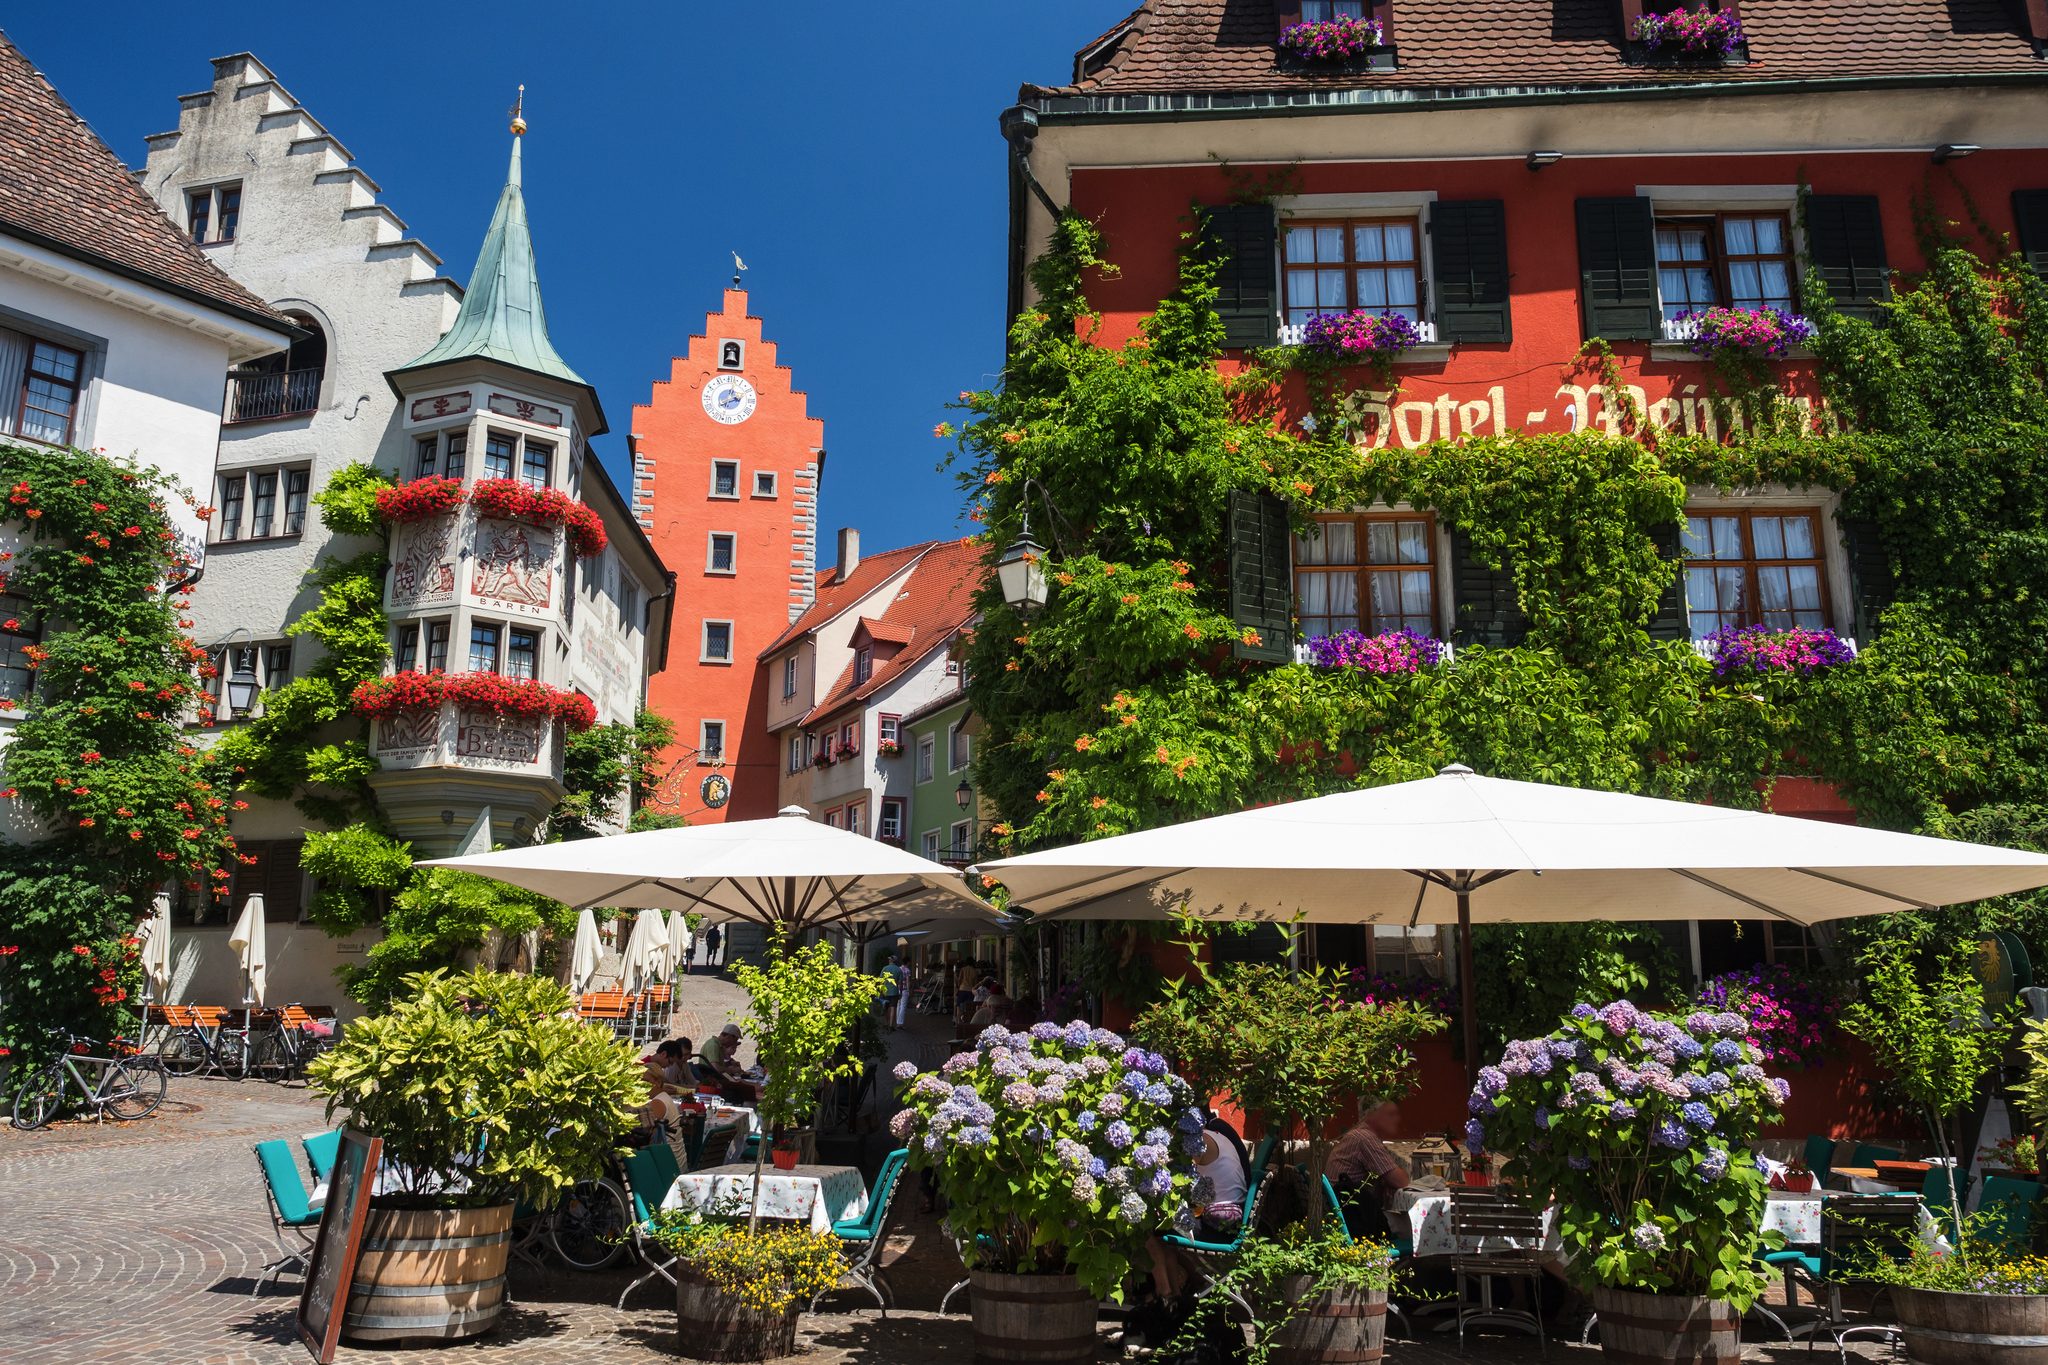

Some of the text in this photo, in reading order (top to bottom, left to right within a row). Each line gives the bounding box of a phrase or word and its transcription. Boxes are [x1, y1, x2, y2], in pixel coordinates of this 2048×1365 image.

[1343, 385, 1516, 457] Hotel
[479, 597, 540, 614] BÄREN
[465, 728, 527, 758] Bären
